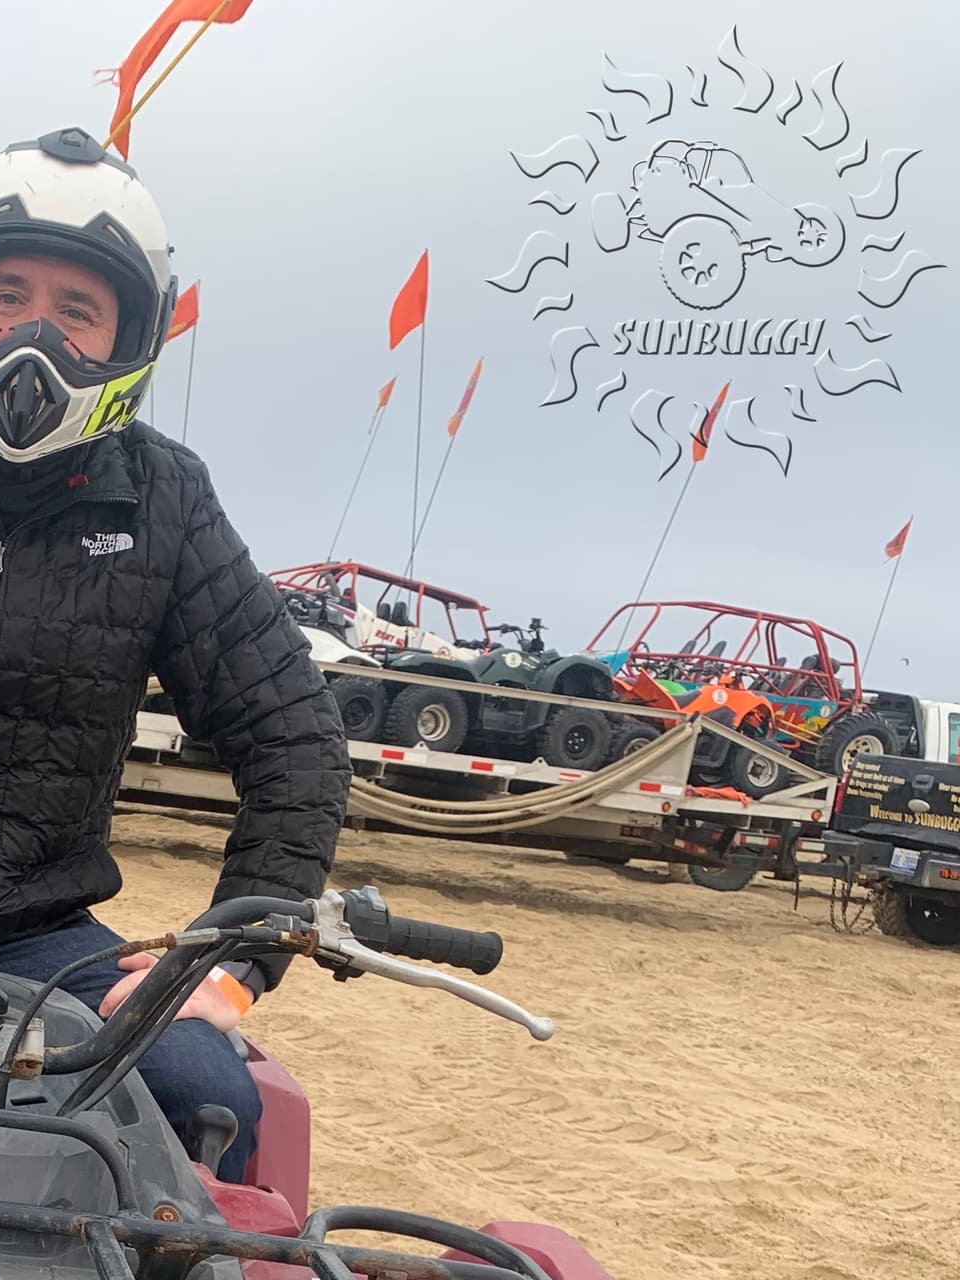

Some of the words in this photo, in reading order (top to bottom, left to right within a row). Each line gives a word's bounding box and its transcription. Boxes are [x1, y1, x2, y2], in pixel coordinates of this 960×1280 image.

[95, 533, 116, 541] THE
[81, 536, 116, 549] NORTH
[89, 546, 115, 556] FACE
